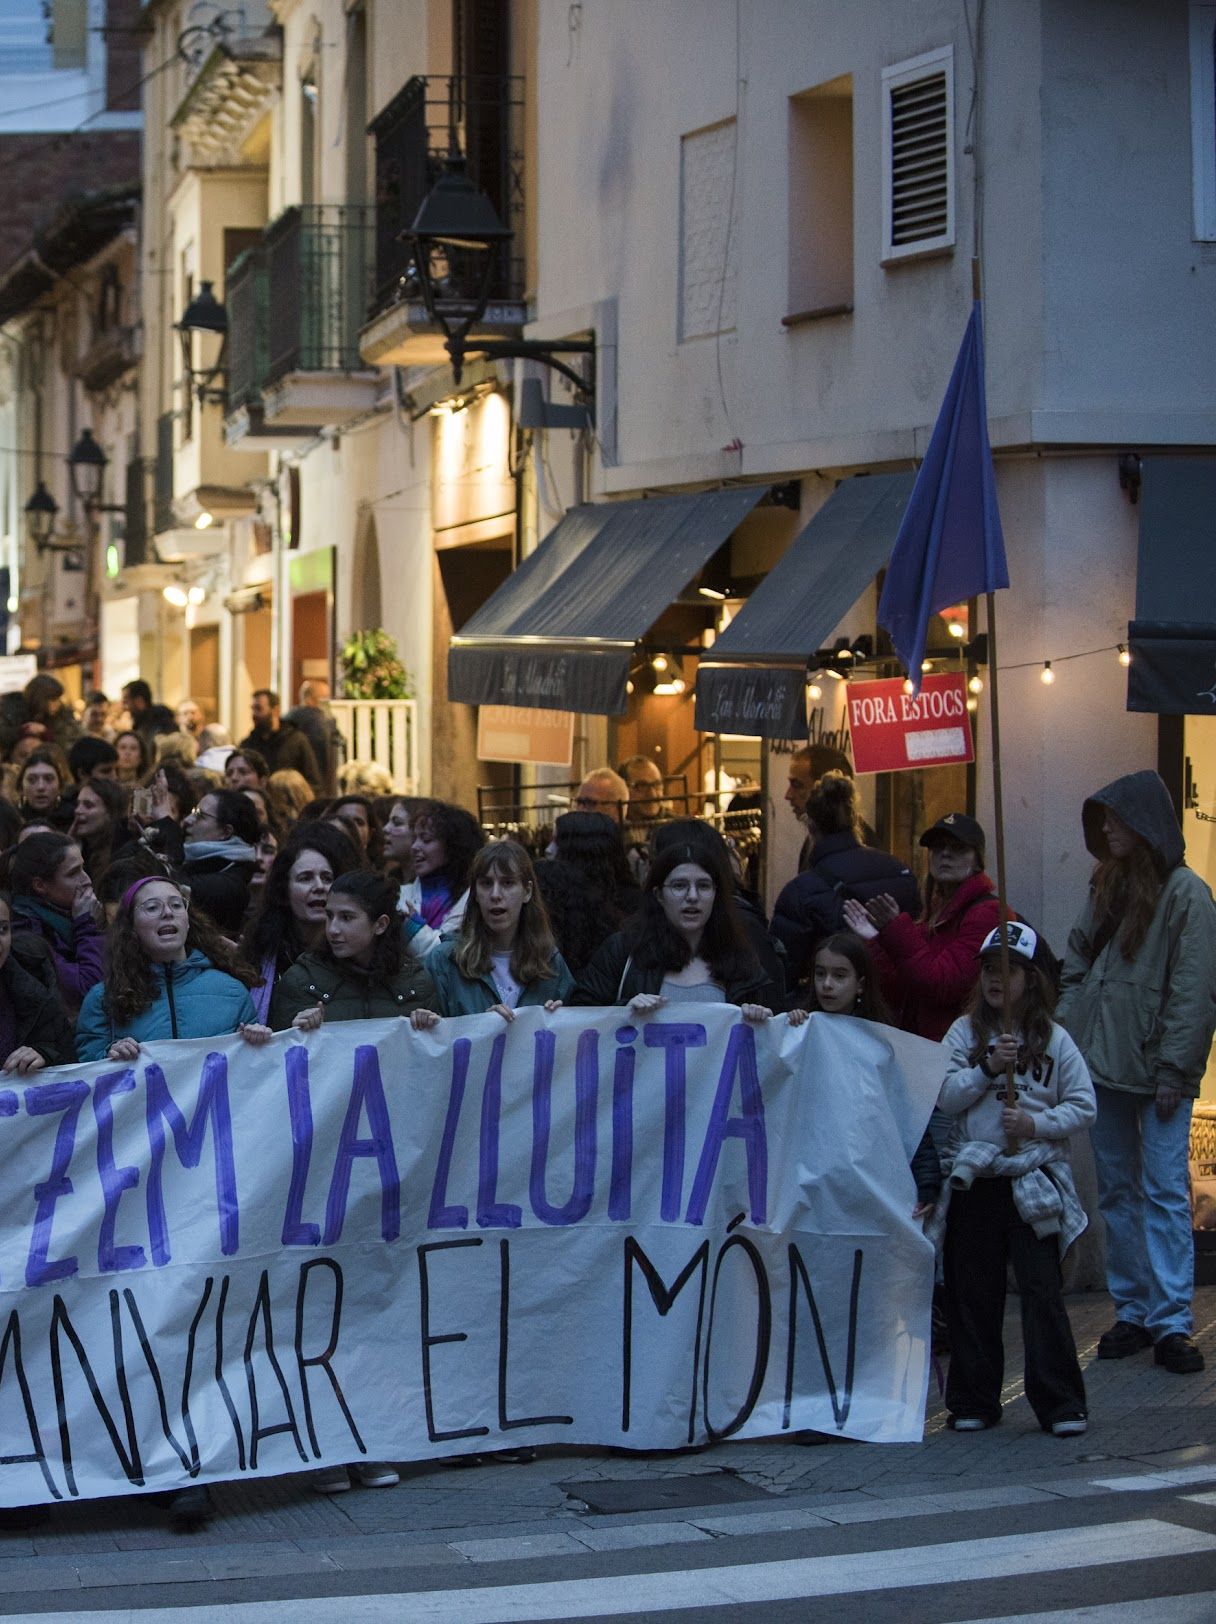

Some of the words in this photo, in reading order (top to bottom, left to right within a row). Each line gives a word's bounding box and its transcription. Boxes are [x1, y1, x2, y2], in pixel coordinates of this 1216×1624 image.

[851, 696, 898, 727] FORA
[899, 688, 964, 722] ESTOCS
[281, 1044, 402, 1247] LA
[416, 1237, 574, 1443] EL
[621, 1211, 863, 1444] MÓN
